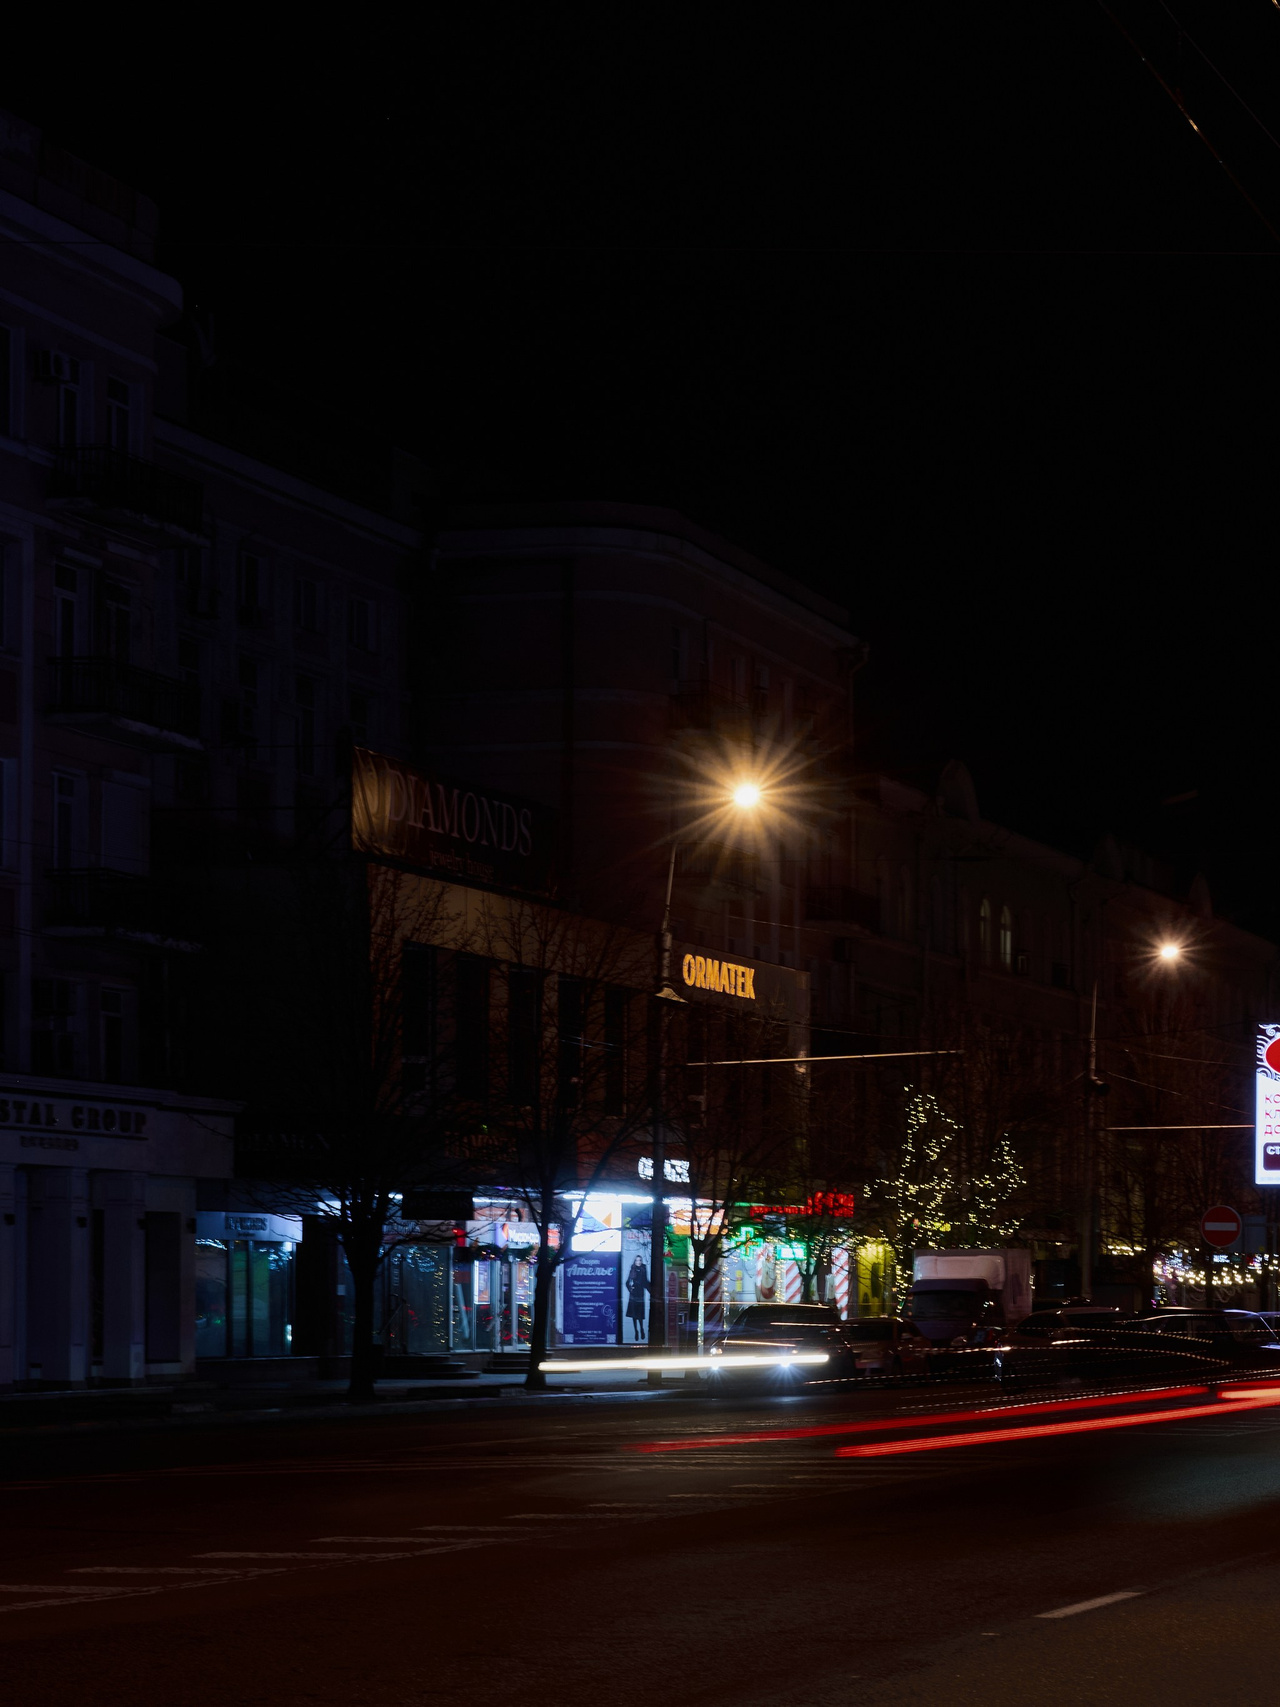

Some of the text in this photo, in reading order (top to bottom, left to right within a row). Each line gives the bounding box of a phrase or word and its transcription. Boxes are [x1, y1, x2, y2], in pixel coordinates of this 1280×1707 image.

[387, 768, 532, 856] DIAMONDS
[682, 953, 756, 999] ORMATEK
[71, 1105, 147, 1133] GROUP
[566, 1263, 614, 1277] Ателье
